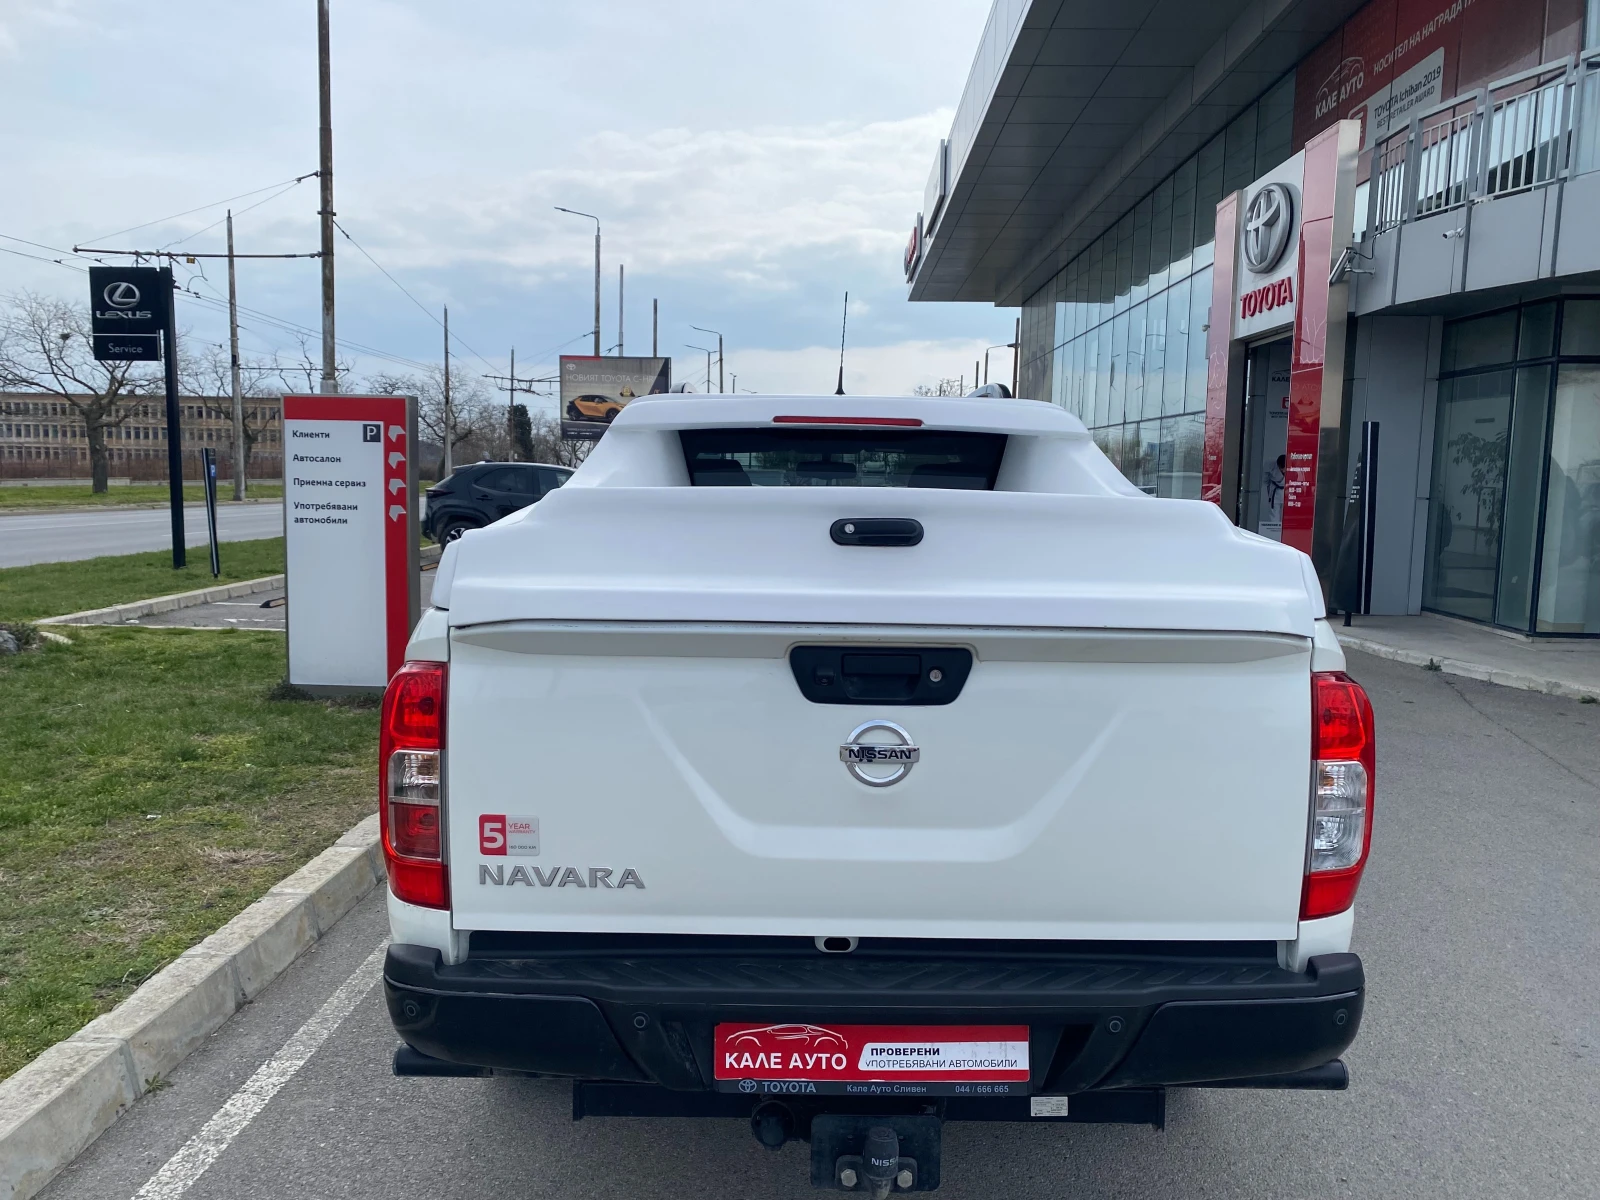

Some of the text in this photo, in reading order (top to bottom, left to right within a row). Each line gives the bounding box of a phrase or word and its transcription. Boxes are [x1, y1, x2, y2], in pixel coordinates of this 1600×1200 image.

[1373, 0, 1464, 76] НОСИТЕЛ НА НАГРАДА
[1315, 72, 1364, 120] КАЛЕ АУТО
[1373, 66, 1442, 119] TOYOTA Ichiban 2019
[1376, 86, 1435, 129] BEST RETAILER AWARD
[1240, 276, 1293, 320] TOYOTA
[95, 310, 152, 319] LEXUS
[108, 343, 143, 353] Service
[565, 373, 599, 382] НОВИЯТ
[601, 374, 631, 383] TOYOTA
[292, 430, 330, 439] Клиенти
[366, 426, 377, 440] P
[292, 453, 342, 463] Автосалон
[293, 477, 367, 489] Приемна сервиз
[293, 501, 359, 512] Употребявани
[293, 515, 348, 525] автомобили
[848, 748, 912, 760] NISSAN
[508, 822, 531, 830] YEAR
[482, 822, 504, 849] 5
[479, 863, 646, 889] NAVARA
[870, 1047, 940, 1057] ПРОВЕРЕНИ
[725, 1052, 847, 1071] КАЛЕ АУТО
[948, 1058, 1018, 1069] АВТОМОБИЛИ
[762, 1081, 817, 1093] TOYOTA
[846, 1084, 927, 1095] Кале Ауто Сливен
[955, 1085, 970, 1093] 044
[977, 1085, 992, 1093] 666
[994, 1085, 1009, 1093] 665
